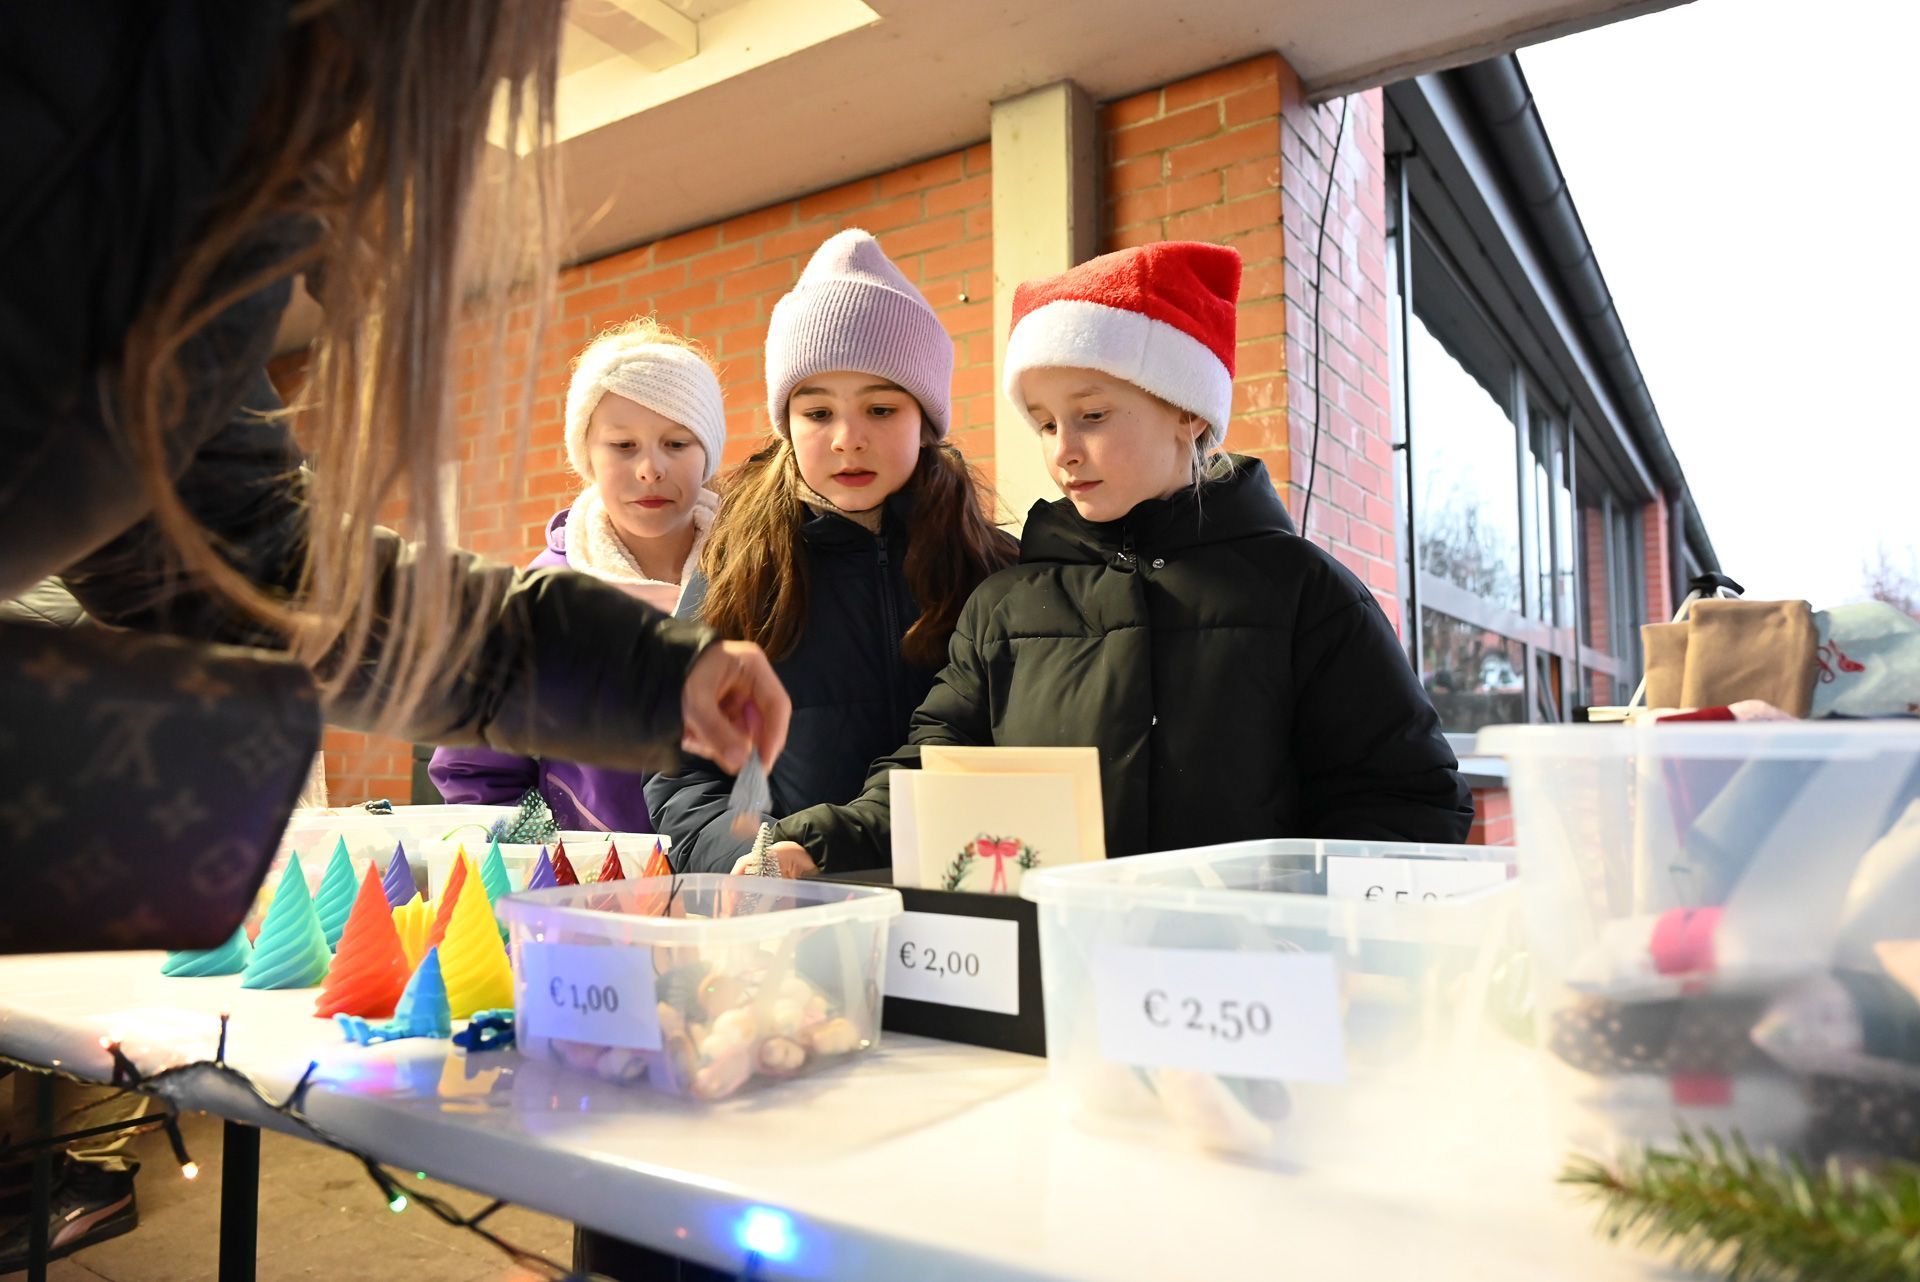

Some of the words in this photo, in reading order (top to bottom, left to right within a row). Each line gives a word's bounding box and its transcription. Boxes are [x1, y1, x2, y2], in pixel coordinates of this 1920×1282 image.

[900, 941, 916, 968] €
[924, 948, 979, 978] 2,00
[550, 976, 565, 1007] €
[571, 984, 619, 1015] 1,00
[1144, 989, 1171, 1028] €
[1181, 997, 1271, 1041] 2,50
